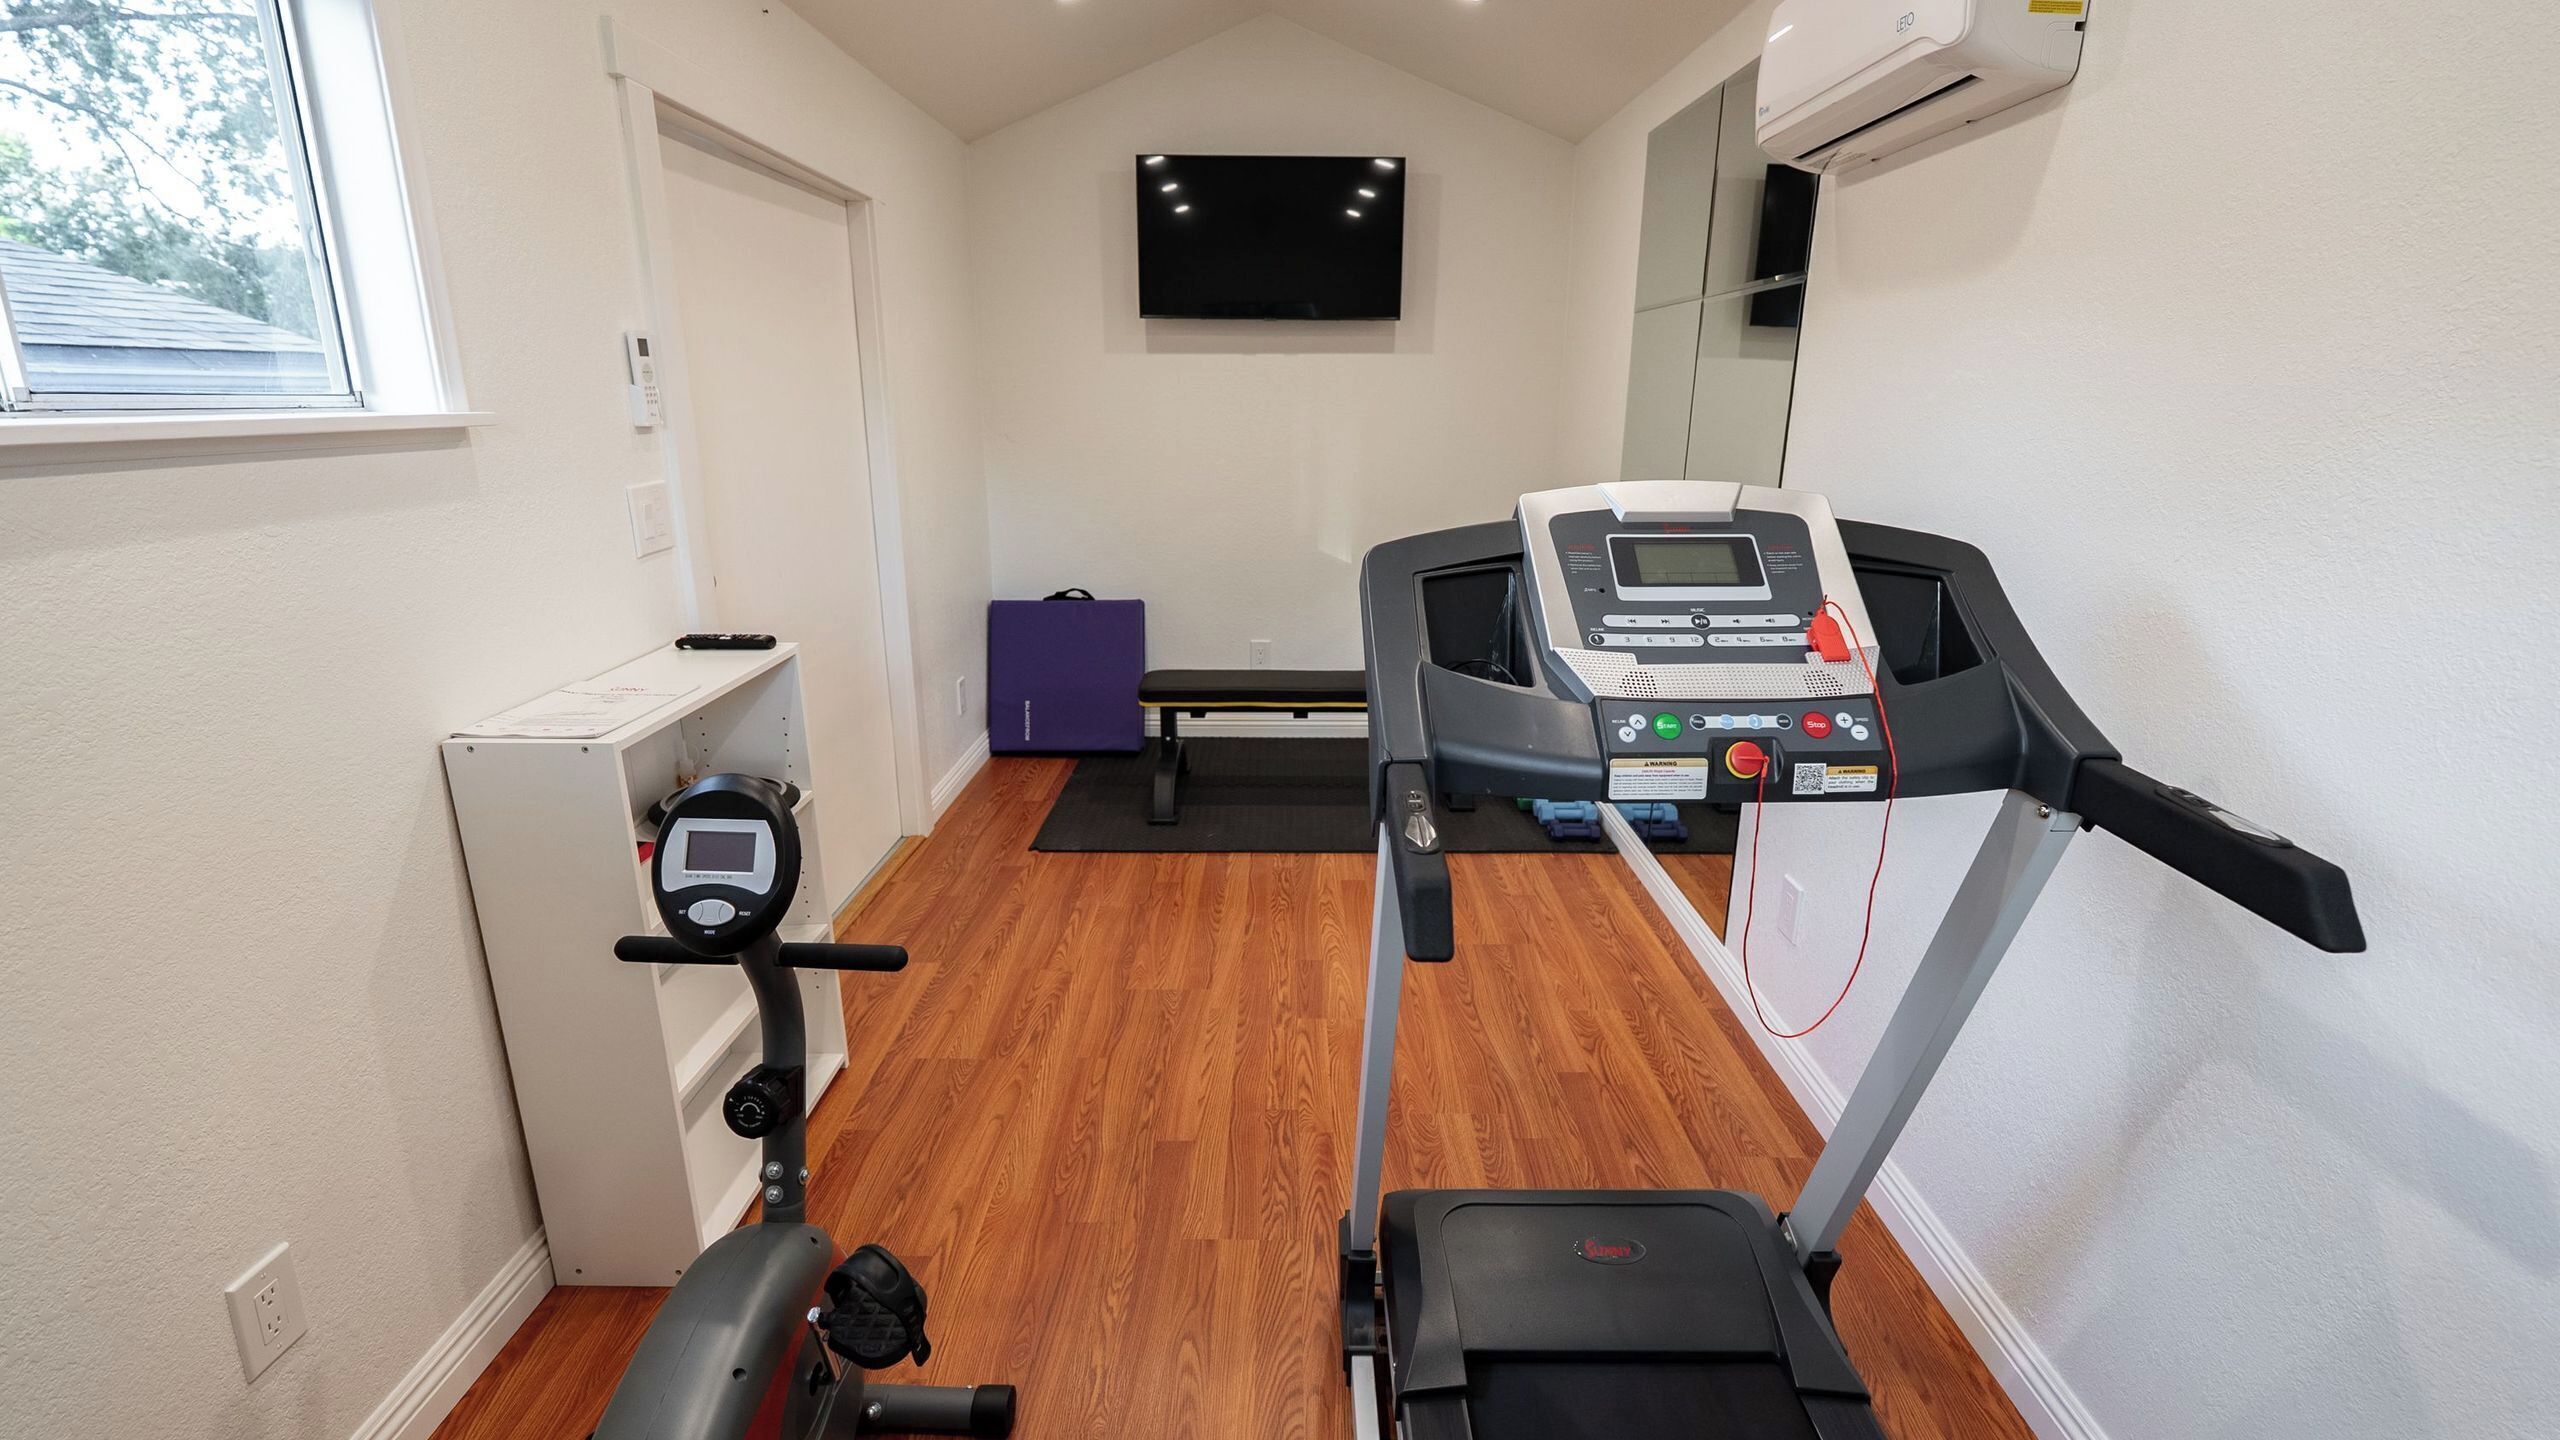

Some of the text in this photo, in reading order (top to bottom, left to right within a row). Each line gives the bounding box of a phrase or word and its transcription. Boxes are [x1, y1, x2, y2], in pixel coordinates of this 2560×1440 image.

[1896, 11, 1915, 33] LETO
[1657, 718, 1677, 730] START
[1806, 720, 1827, 729] Stop
